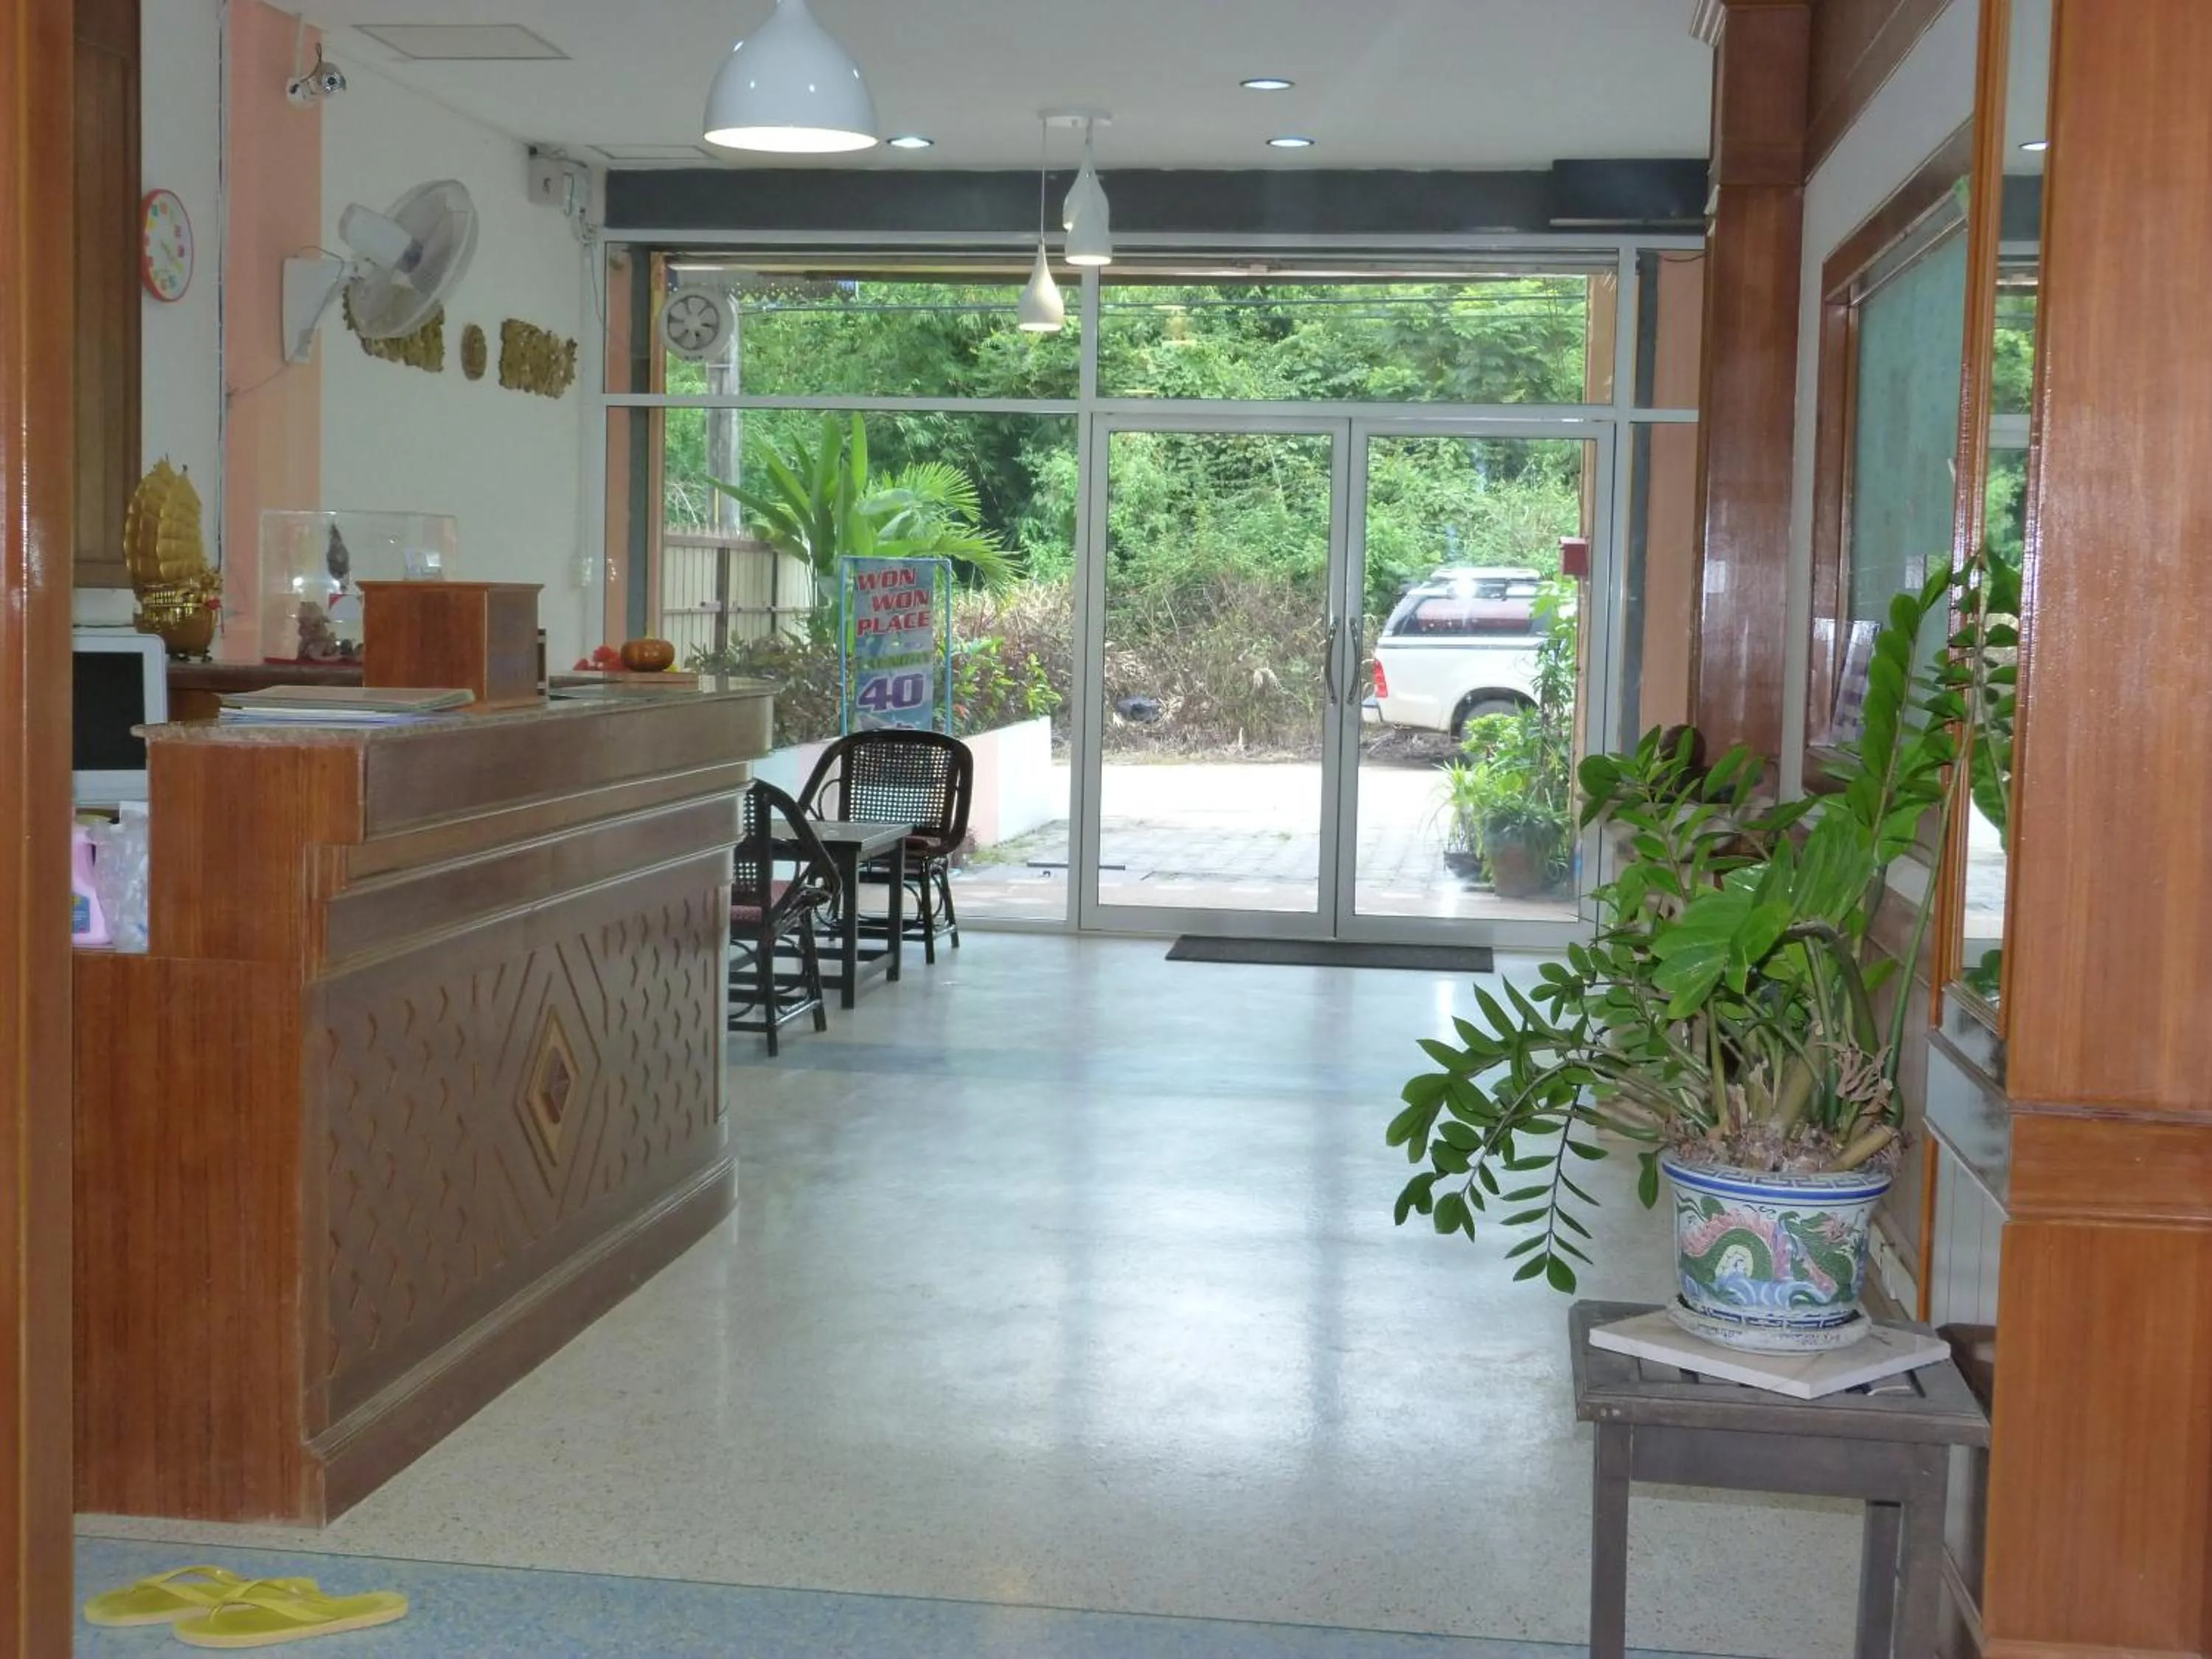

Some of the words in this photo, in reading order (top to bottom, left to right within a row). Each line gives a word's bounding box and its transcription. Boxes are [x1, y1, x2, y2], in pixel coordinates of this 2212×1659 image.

[858, 567, 917, 591] WON
[872, 589, 930, 612] WON
[857, 610, 931, 636] PLACE
[857, 672, 926, 713] 40
